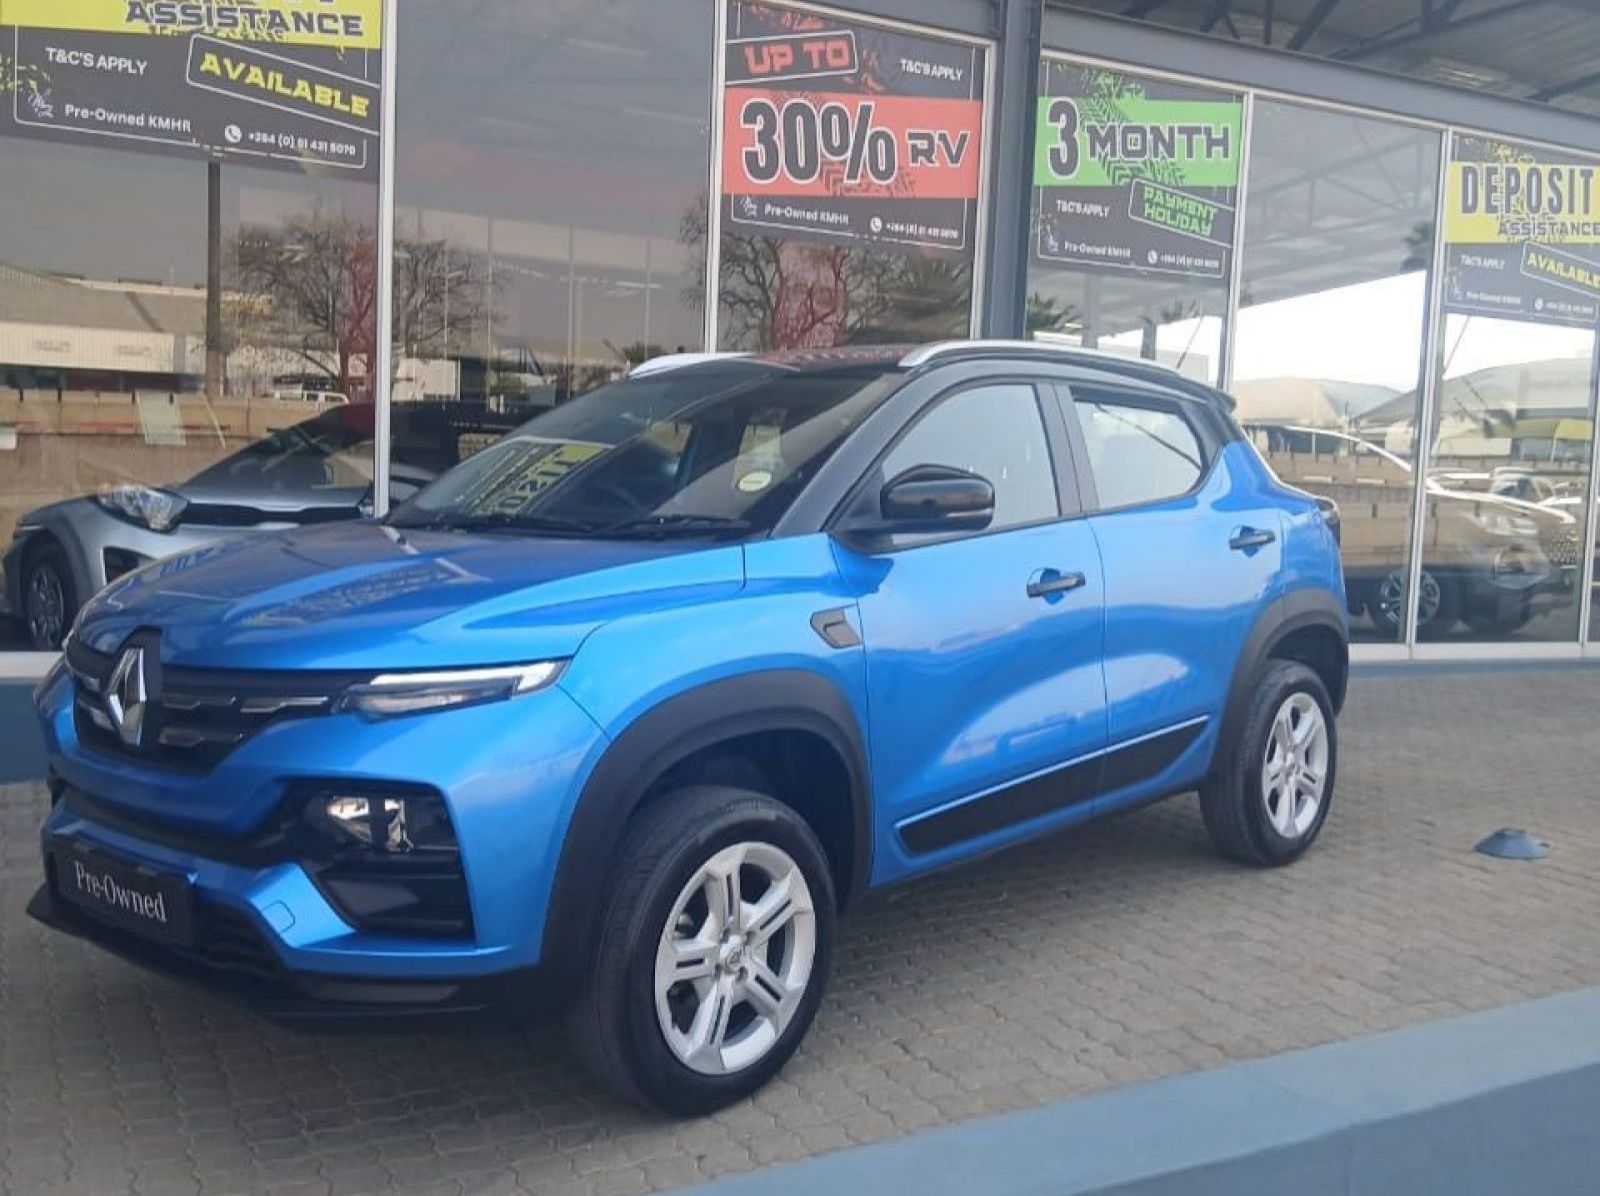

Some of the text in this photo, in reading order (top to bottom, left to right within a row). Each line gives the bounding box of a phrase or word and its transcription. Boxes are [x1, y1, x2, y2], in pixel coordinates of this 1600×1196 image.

[126, 0, 364, 37] ASSISTANCE
[45, 47, 148, 76] T&C'S APPLY
[745, 39, 849, 74] UP TO
[200, 52, 370, 118] AVAILABLE
[64, 103, 192, 133] Pre-Owned KMHR
[740, 98, 970, 184] 30% RV
[1048, 97, 1231, 179] 3 MONTH
[1144, 185, 1218, 220] PAYMENT
[1460, 165, 1594, 214] DEPOSIT
[1144, 202, 1212, 237] HOLIDAY
[74, 860, 167, 923] Pre-Owned
